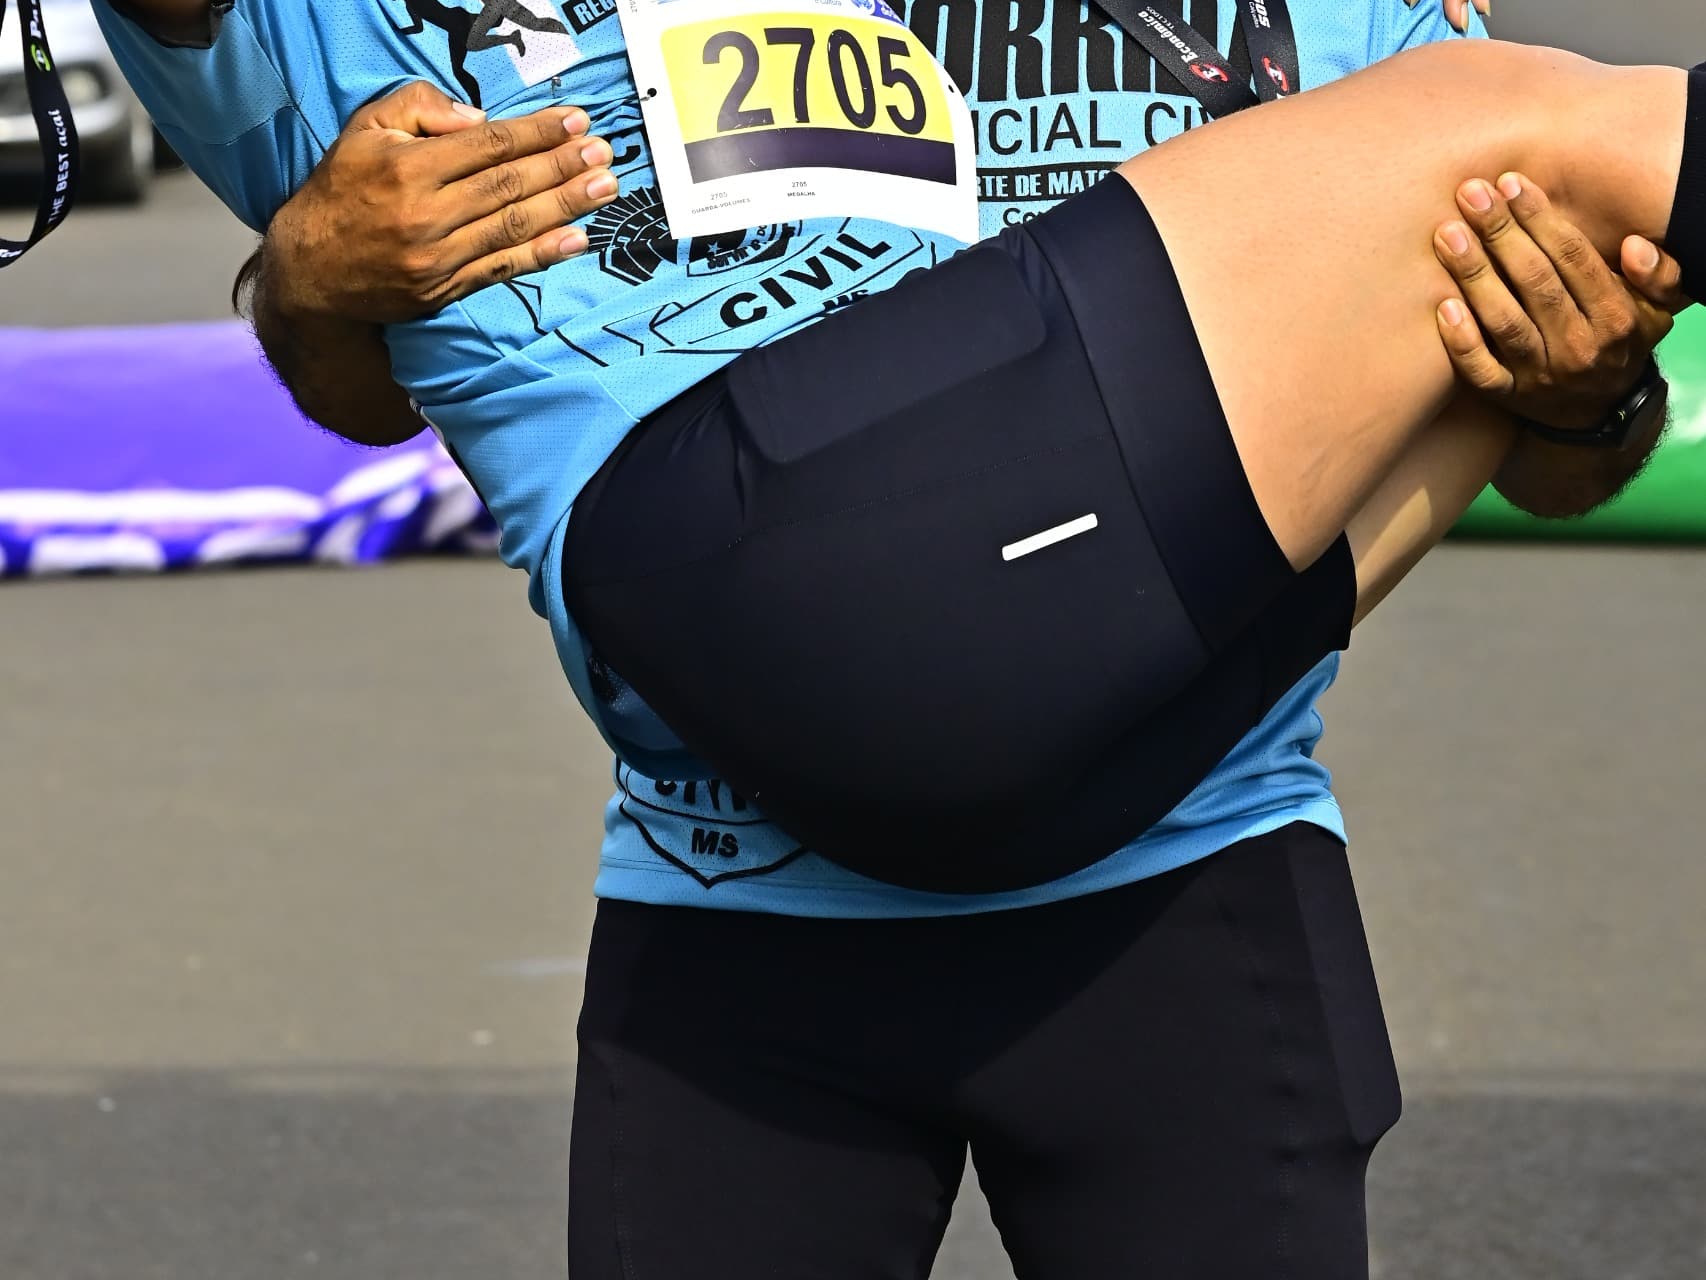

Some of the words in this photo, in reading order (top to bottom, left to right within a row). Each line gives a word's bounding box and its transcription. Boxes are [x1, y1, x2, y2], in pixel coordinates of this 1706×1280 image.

[702, 26, 927, 135] 2705
[55, 152, 70, 193] BEST
[1015, 174, 1042, 198] DE
[47, 194, 65, 224] THE
[691, 198, 751, 215] GUARDA-VOLUMES
[710, 191, 728, 201] 2705
[719, 233, 893, 328] CIVIL
[691, 827, 740, 858] MS
